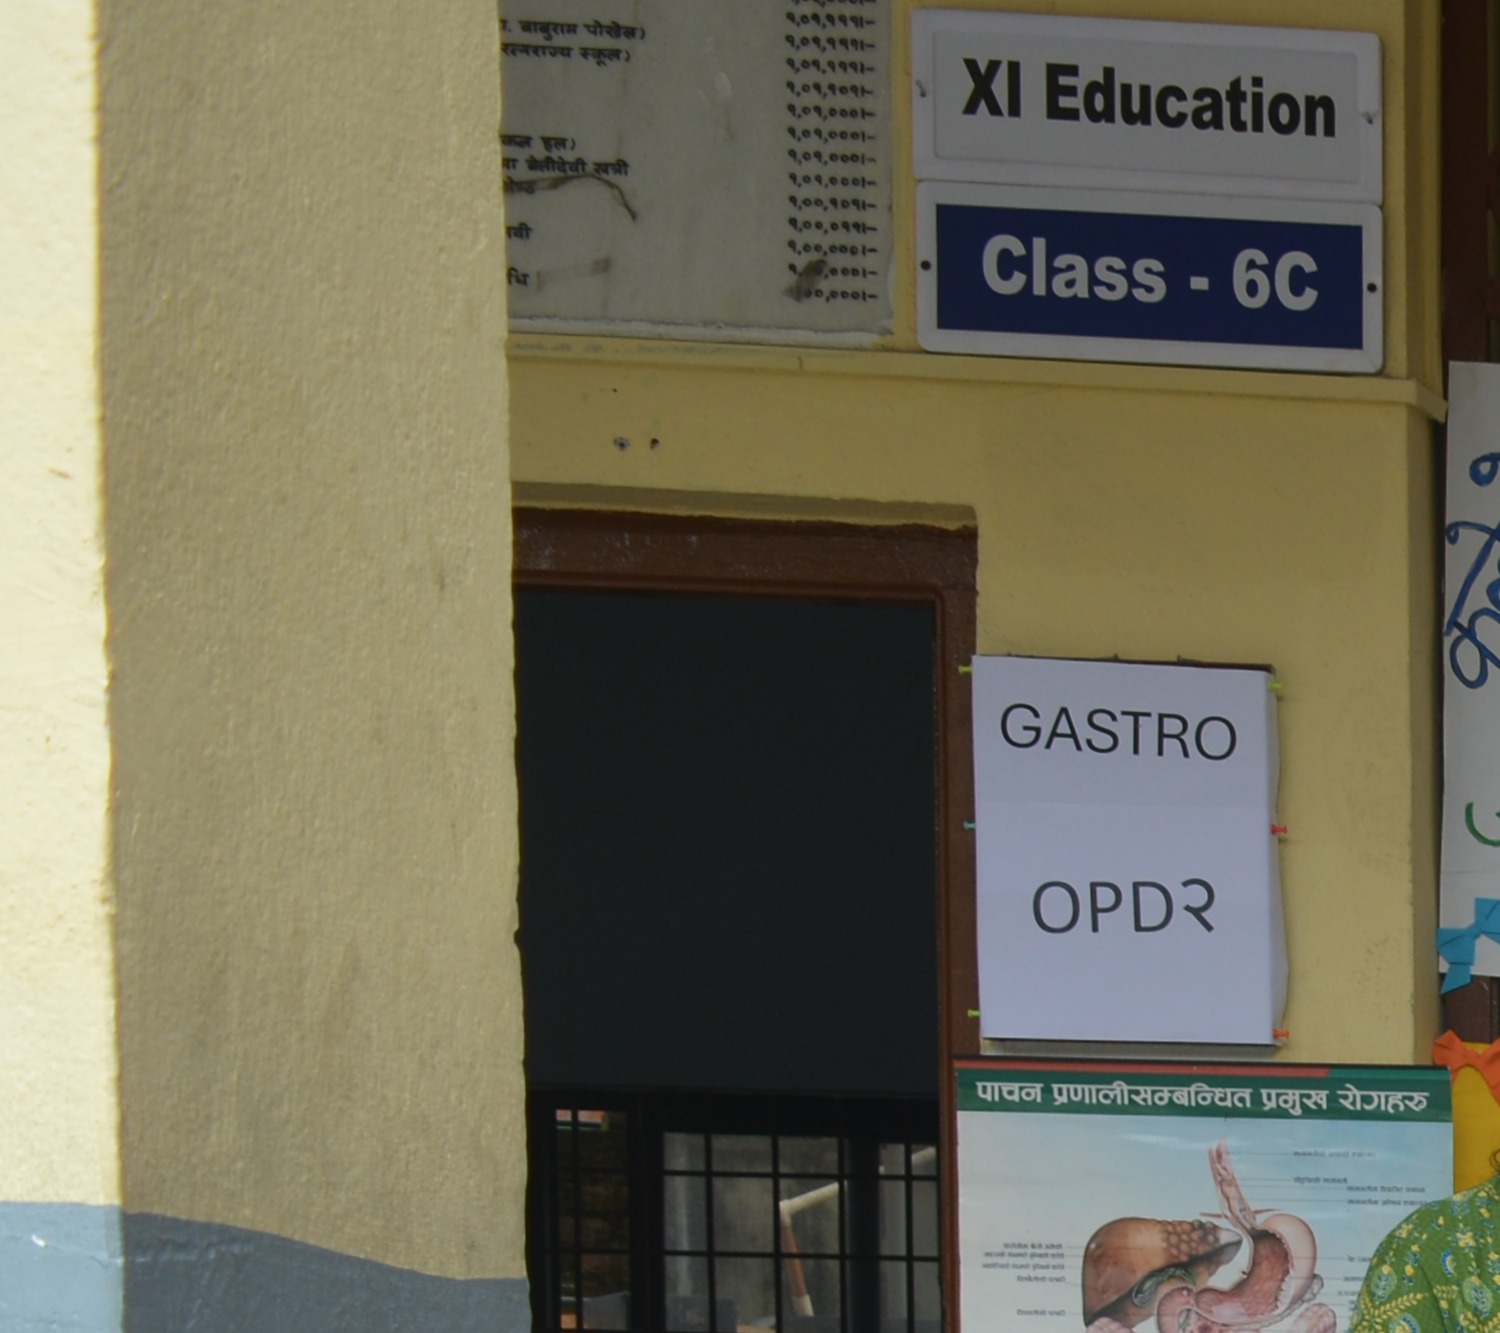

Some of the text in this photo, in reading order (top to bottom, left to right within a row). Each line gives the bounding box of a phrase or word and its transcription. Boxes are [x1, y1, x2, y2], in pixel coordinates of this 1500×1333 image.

[962, 57, 1338, 139] XI Education
[981, 234, 1320, 311] Class - 6C
[1000, 702, 1238, 762] GASTRO
[976, 1079, 1043, 1105] पाचन
[1261, 1086, 1329, 1117] प्रमुख
